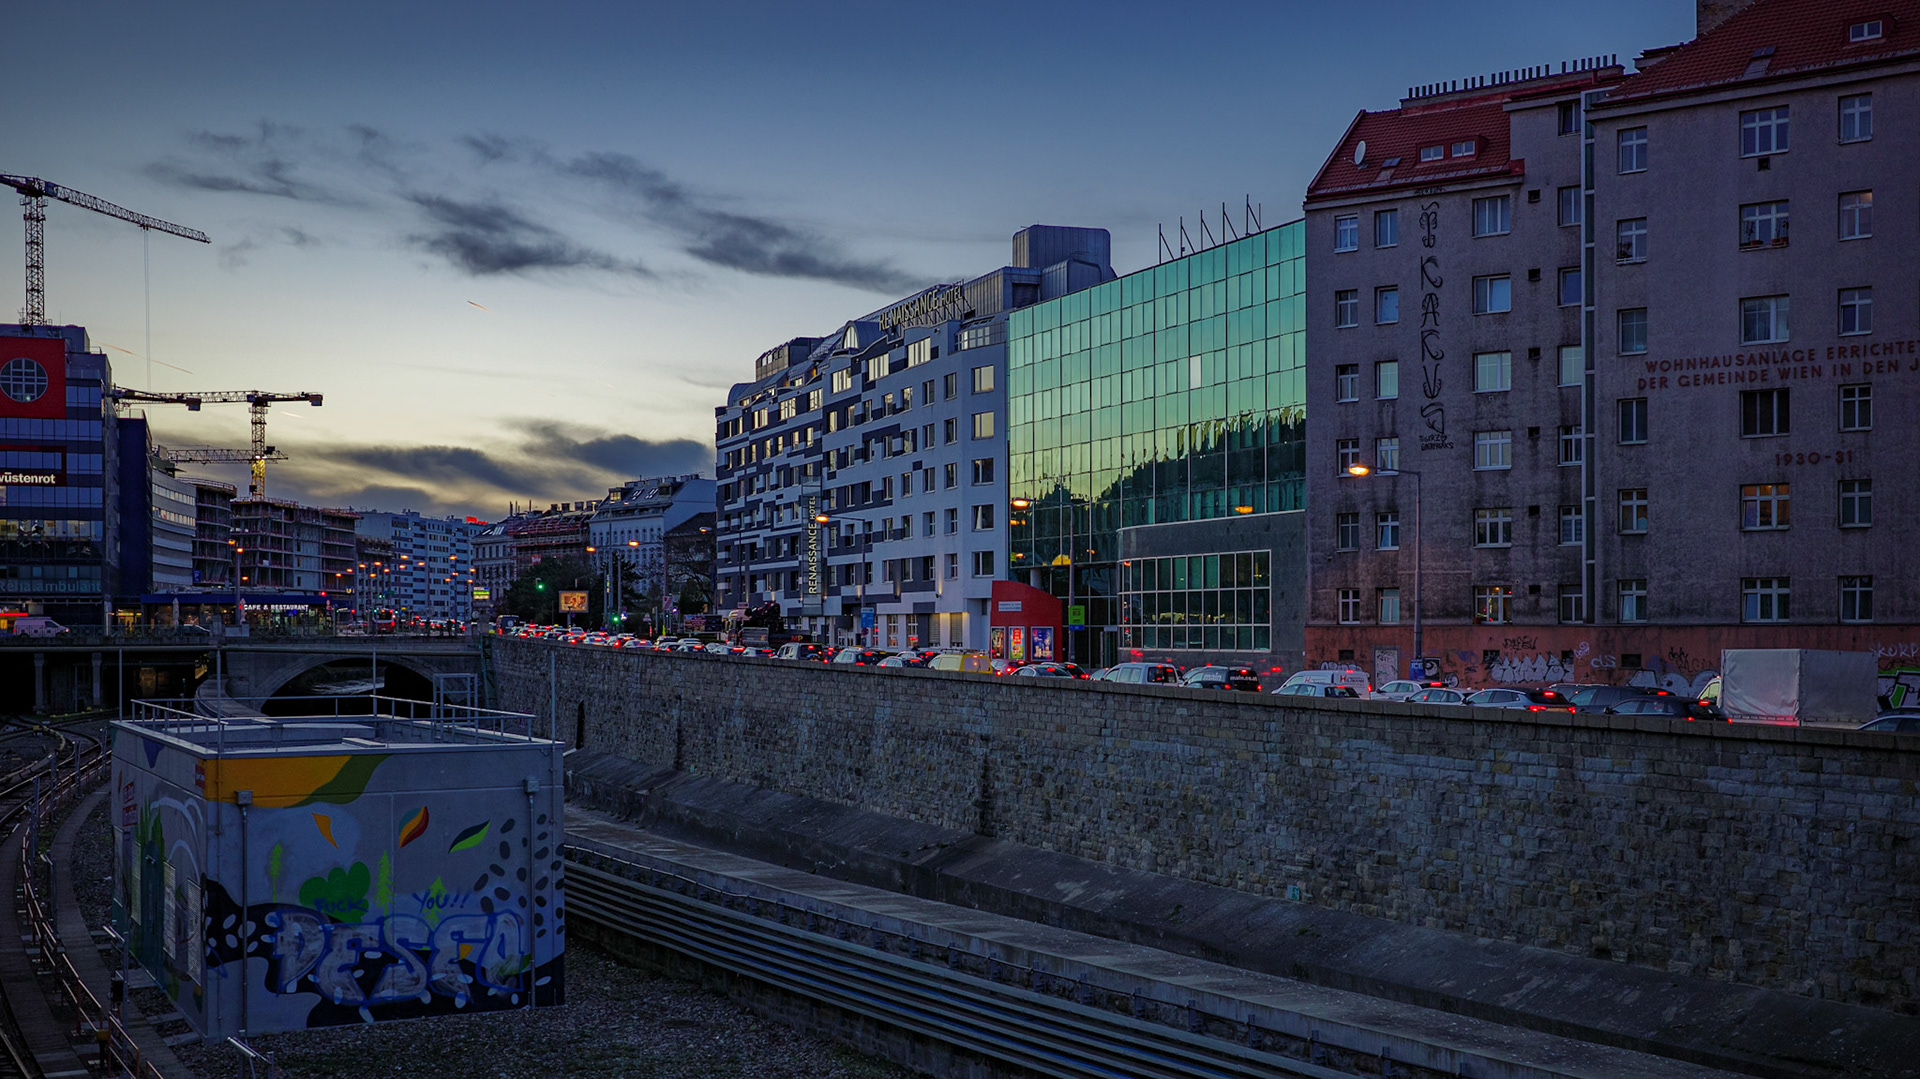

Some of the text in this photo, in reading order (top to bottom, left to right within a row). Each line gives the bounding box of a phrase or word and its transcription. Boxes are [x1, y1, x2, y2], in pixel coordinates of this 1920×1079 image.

[880, 285, 963, 331] RENAISSANCE HOTEL
[1645, 340, 1920, 373] WOHNHAUSANLAGE ERRICHTE
[1638, 376, 1668, 390] DER
[1678, 369, 1768, 387] GEMEINDE
[1778, 365, 1821, 379] WIEN
[1833, 363, 1851, 377] IN
[1863, 359, 1898, 375] DEN
[1775, 450, 1852, 466] 1930-31
[808, 522, 817, 594] RENAISSANCE
